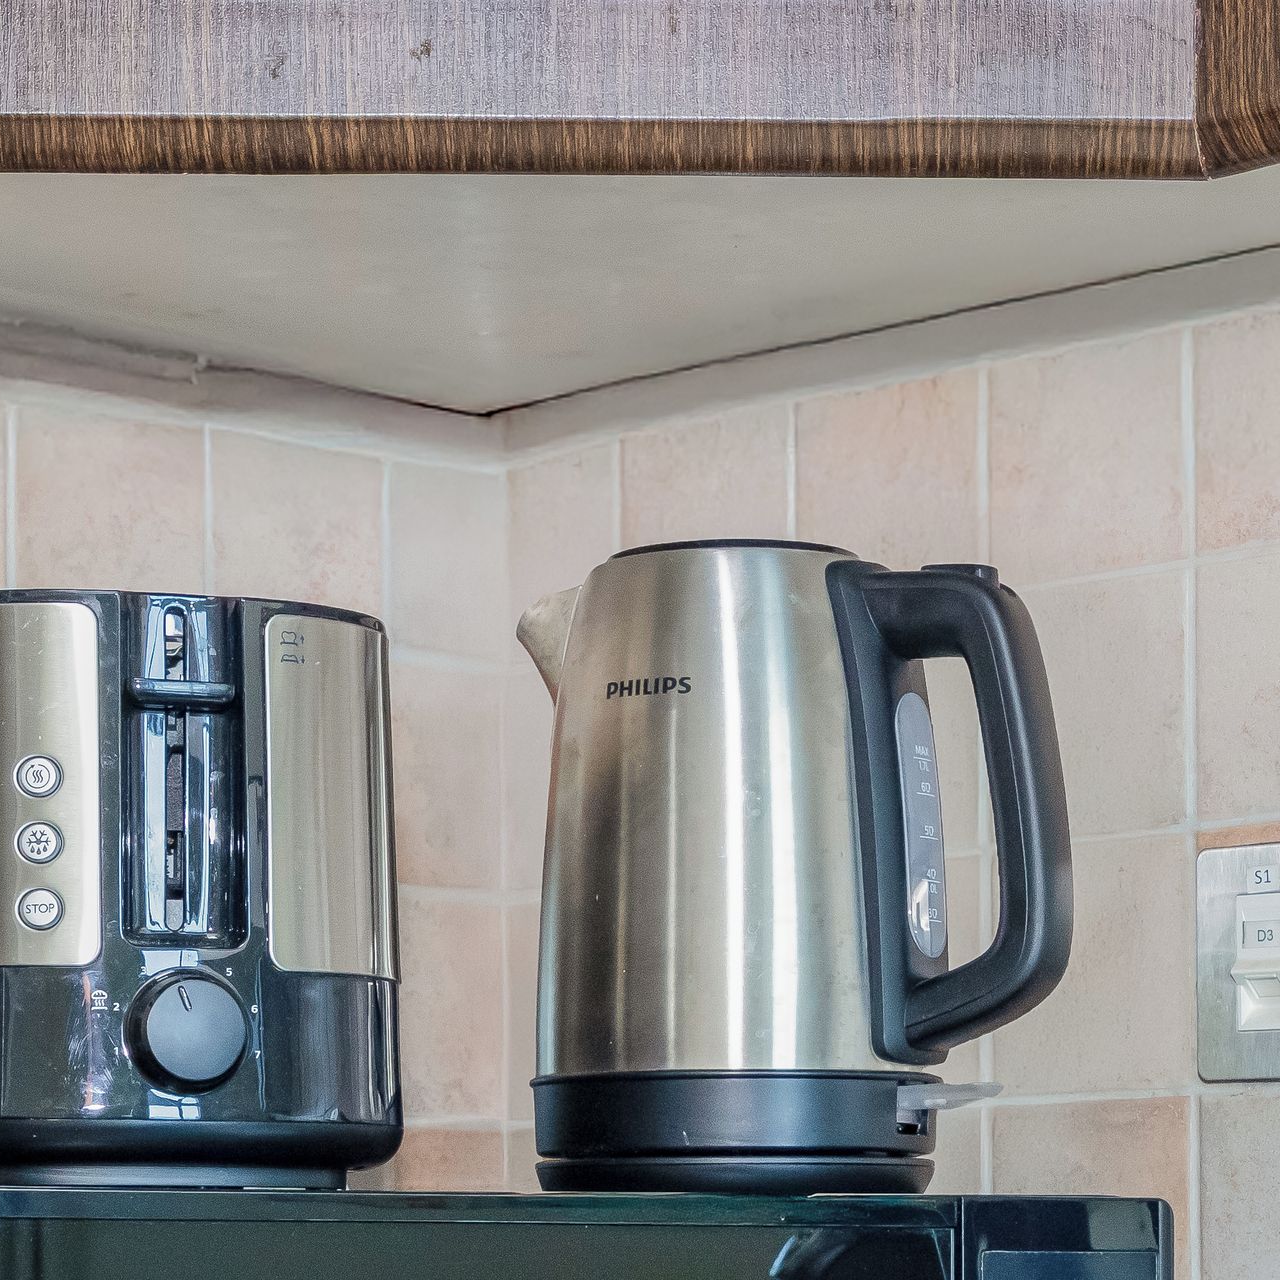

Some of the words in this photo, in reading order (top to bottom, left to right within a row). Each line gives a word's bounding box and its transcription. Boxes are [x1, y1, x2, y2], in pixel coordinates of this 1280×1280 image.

[606, 677, 692, 700] PHILIPS
[1254, 869, 1271, 885] S1
[25, 903, 55, 914] STOP
[1257, 929, 1274, 942] D3
[225, 968, 232, 976] 5
[113, 1003, 120, 1011] 2
[251, 1005, 258, 1013] 6
[254, 1051, 261, 1059] 7
